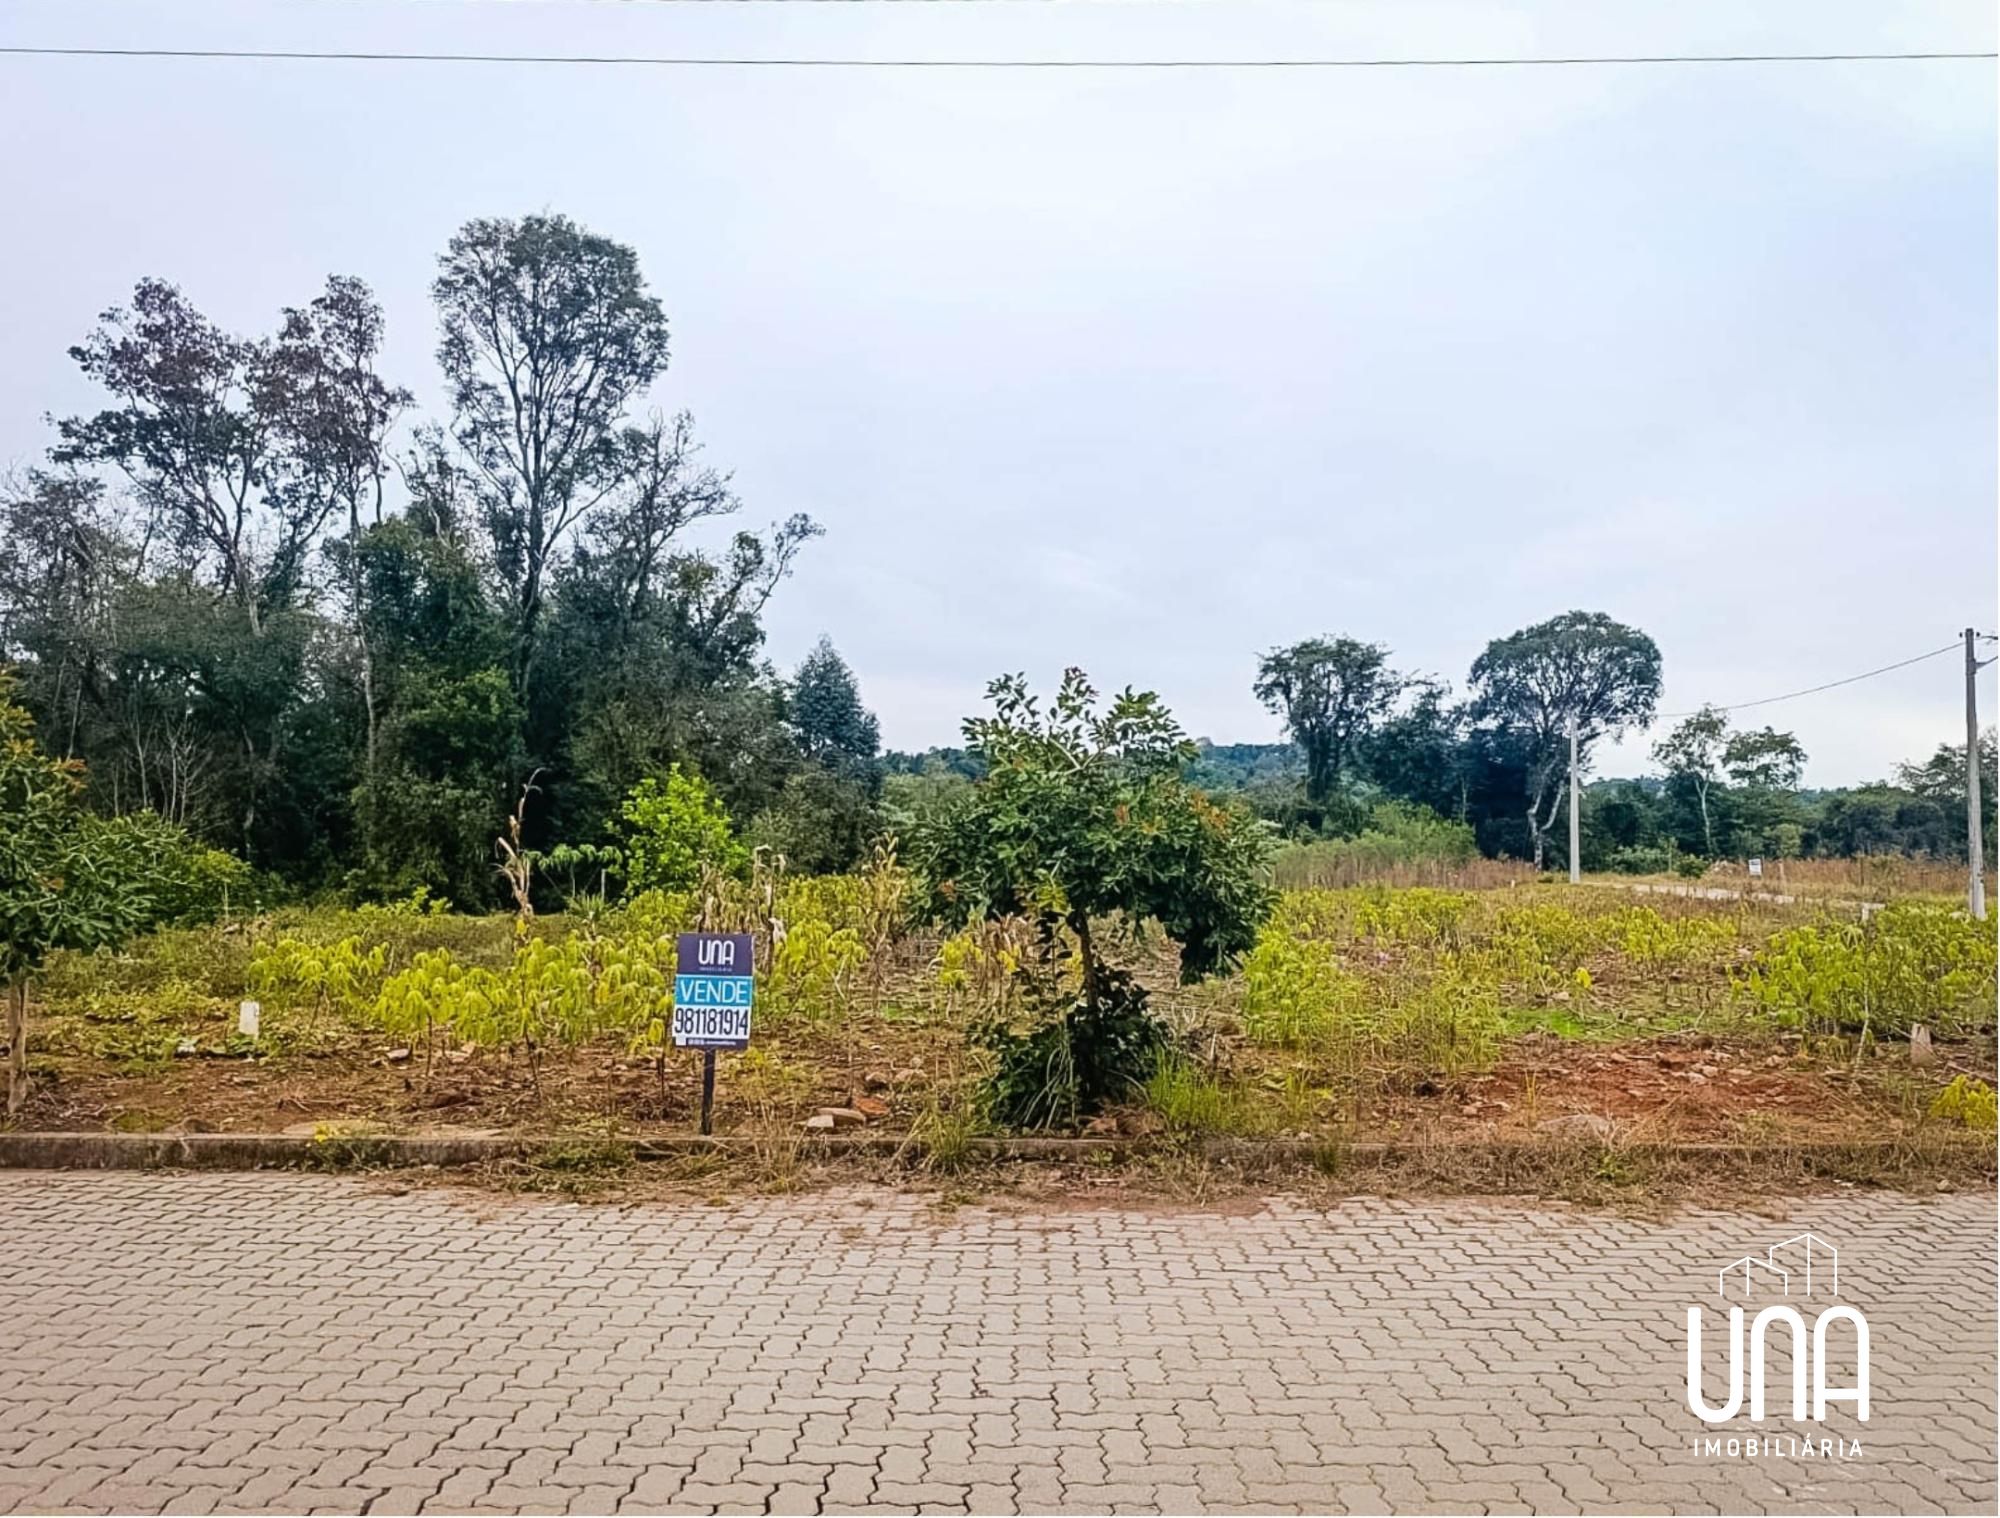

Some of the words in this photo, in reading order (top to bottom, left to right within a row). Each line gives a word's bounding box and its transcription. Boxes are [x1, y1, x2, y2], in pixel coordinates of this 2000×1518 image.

[698, 939, 735, 966] UNA
[680, 979, 749, 1004] VENDE
[674, 1007, 749, 1036] 981181914
